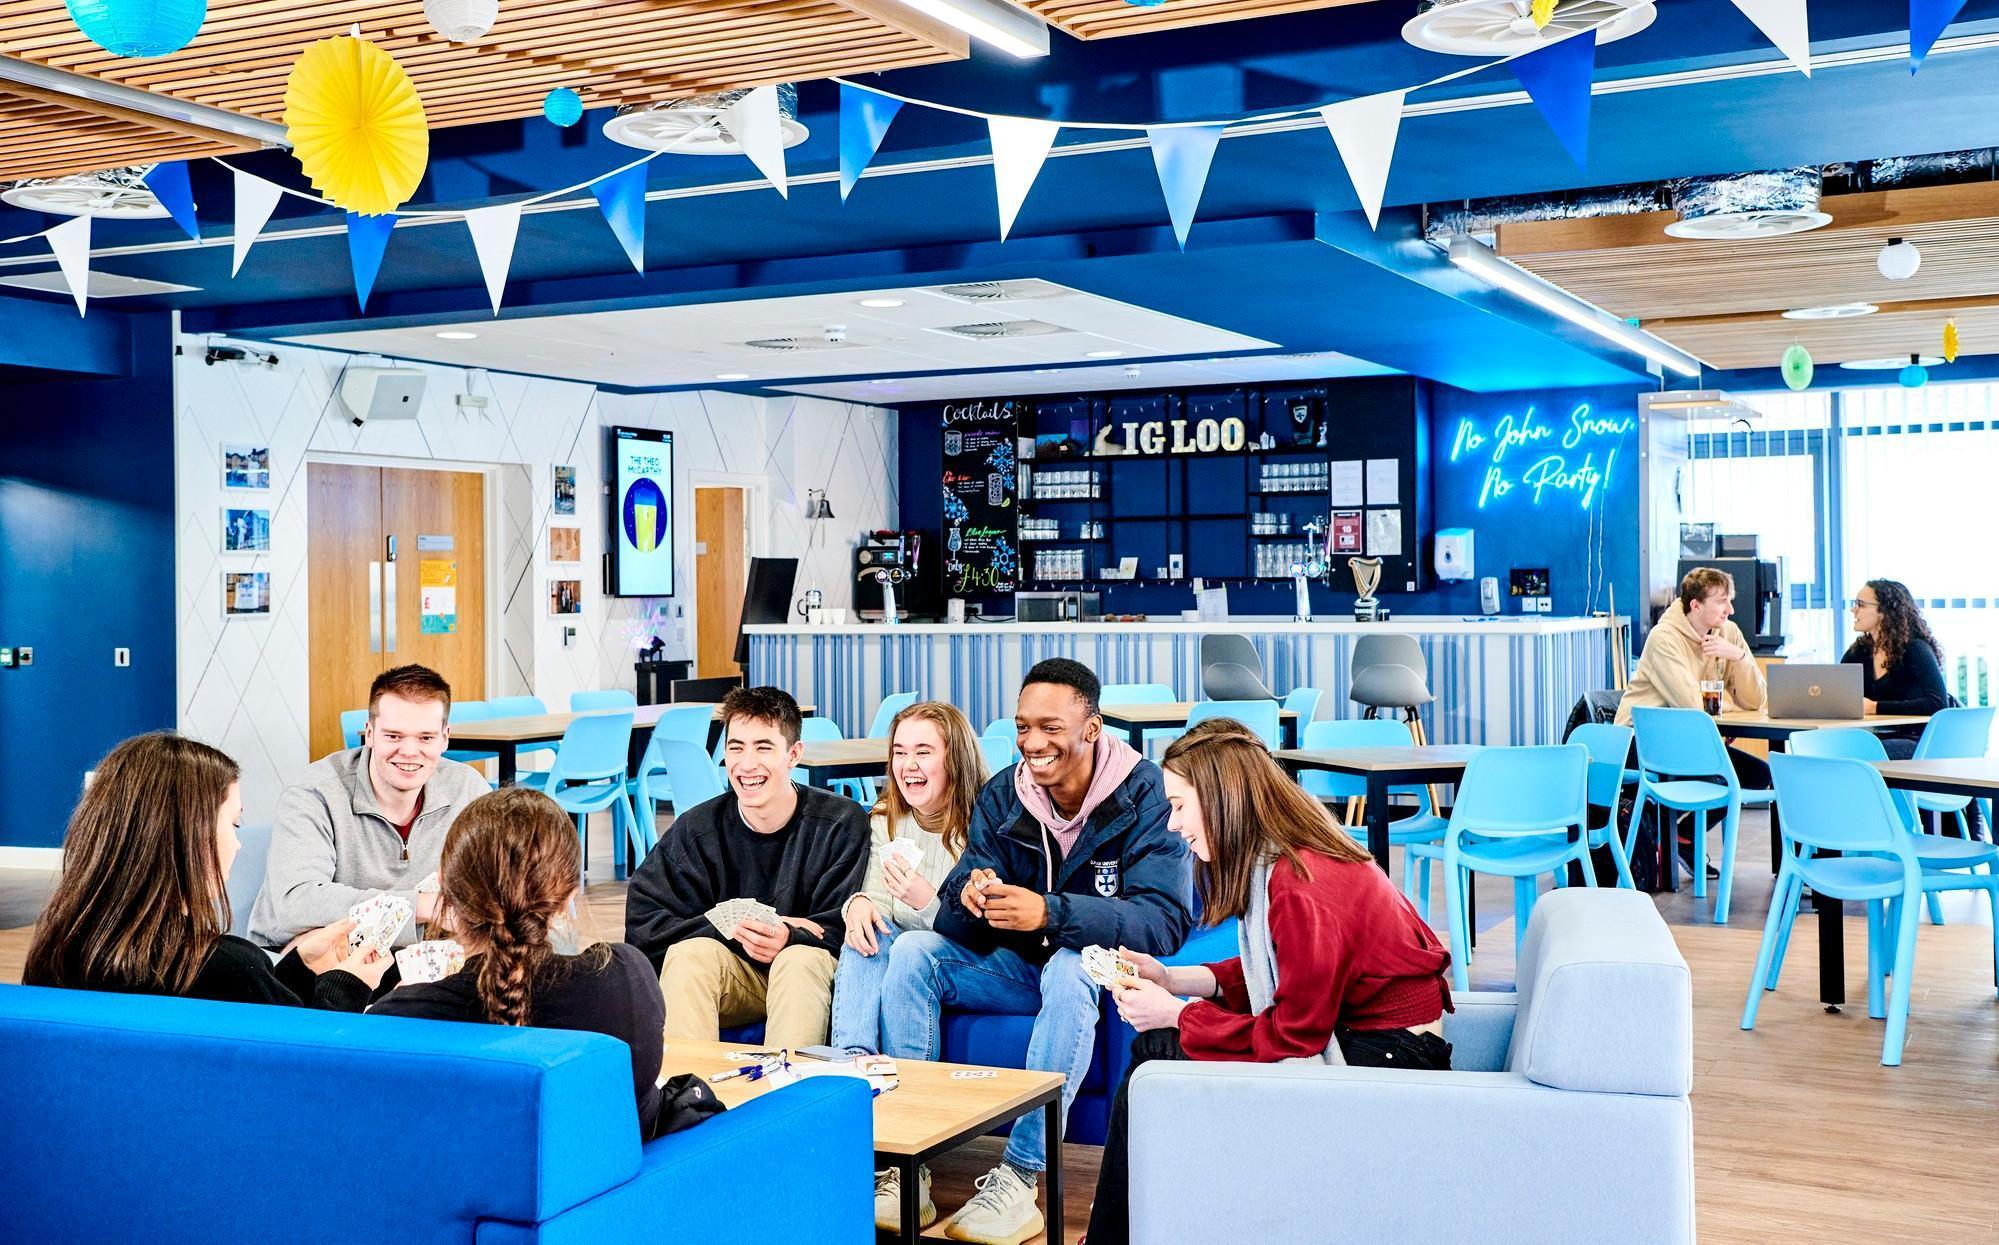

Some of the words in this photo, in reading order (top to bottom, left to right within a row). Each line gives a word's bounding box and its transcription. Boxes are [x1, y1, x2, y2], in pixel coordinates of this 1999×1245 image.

[943, 401, 1013, 425] Cocktails
[1122, 417, 1245, 455] IGLOO
[1451, 417, 1486, 462] No
[1493, 406, 1552, 463] John
[630, 455, 642, 465] THE
[643, 456, 660, 467] THEO
[1479, 466, 1515, 509] No
[1523, 448, 1616, 511] Party!
